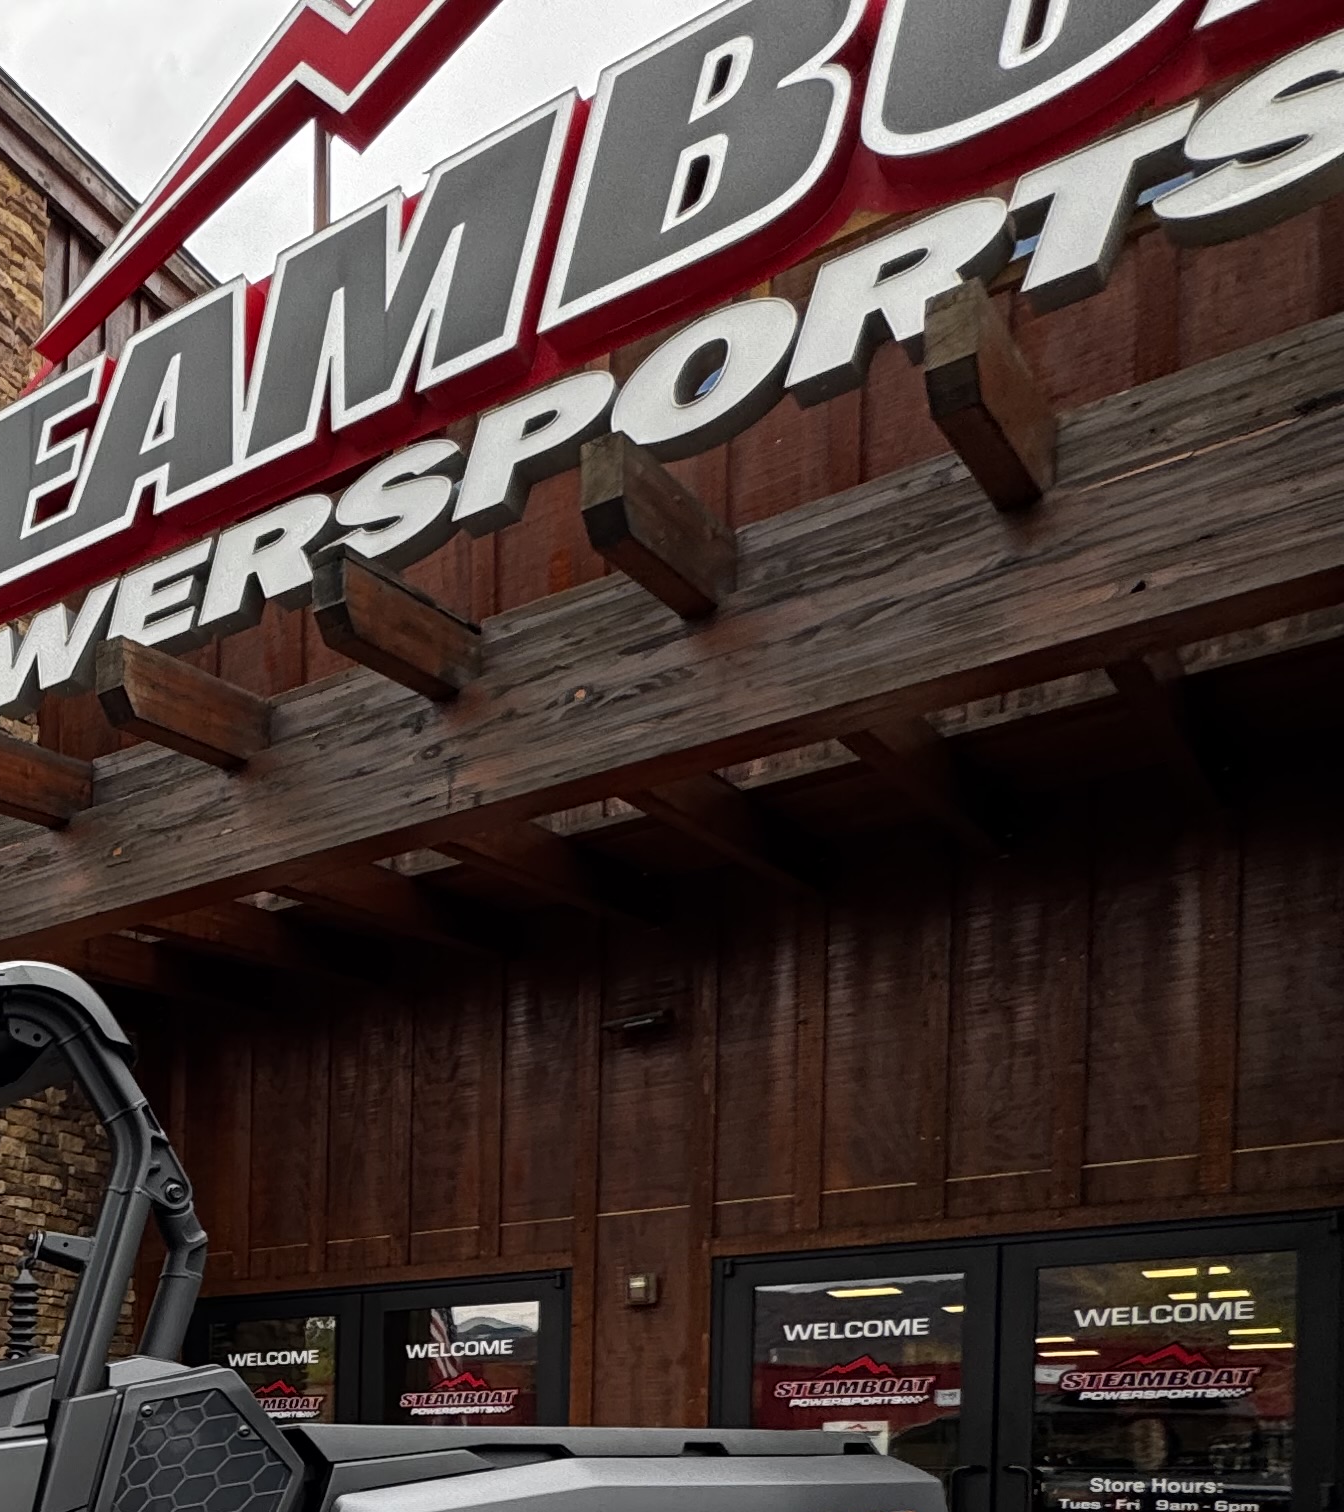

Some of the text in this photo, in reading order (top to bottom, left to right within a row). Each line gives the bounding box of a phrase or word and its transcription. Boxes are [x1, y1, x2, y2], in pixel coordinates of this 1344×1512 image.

[1073, 1299, 1256, 1328] WELCOME
[783, 1317, 930, 1342] WELCOME
[227, 1349, 320, 1367] WELCOME
[405, 1339, 514, 1360] WELCOME
[774, 1375, 937, 1398] STEAMBOAT
[1061, 1366, 1262, 1391] STEAMBOAT
[399, 1389, 519, 1407] STEAMBOAT
[788, 1396, 901, 1408] POWERSPORTS
[1078, 1387, 1219, 1401] POWERSPORTS
[260, 1396, 324, 1411] MBOAT
[410, 1406, 496, 1416] POWERSPORTS
[1090, 1477, 1224, 1494] Store Hours:
[1058, 1498, 1102, 1510] Tues
[1115, 1499, 1140, 1510] Fri
[1155, 1500, 1198, 1511] 9am
